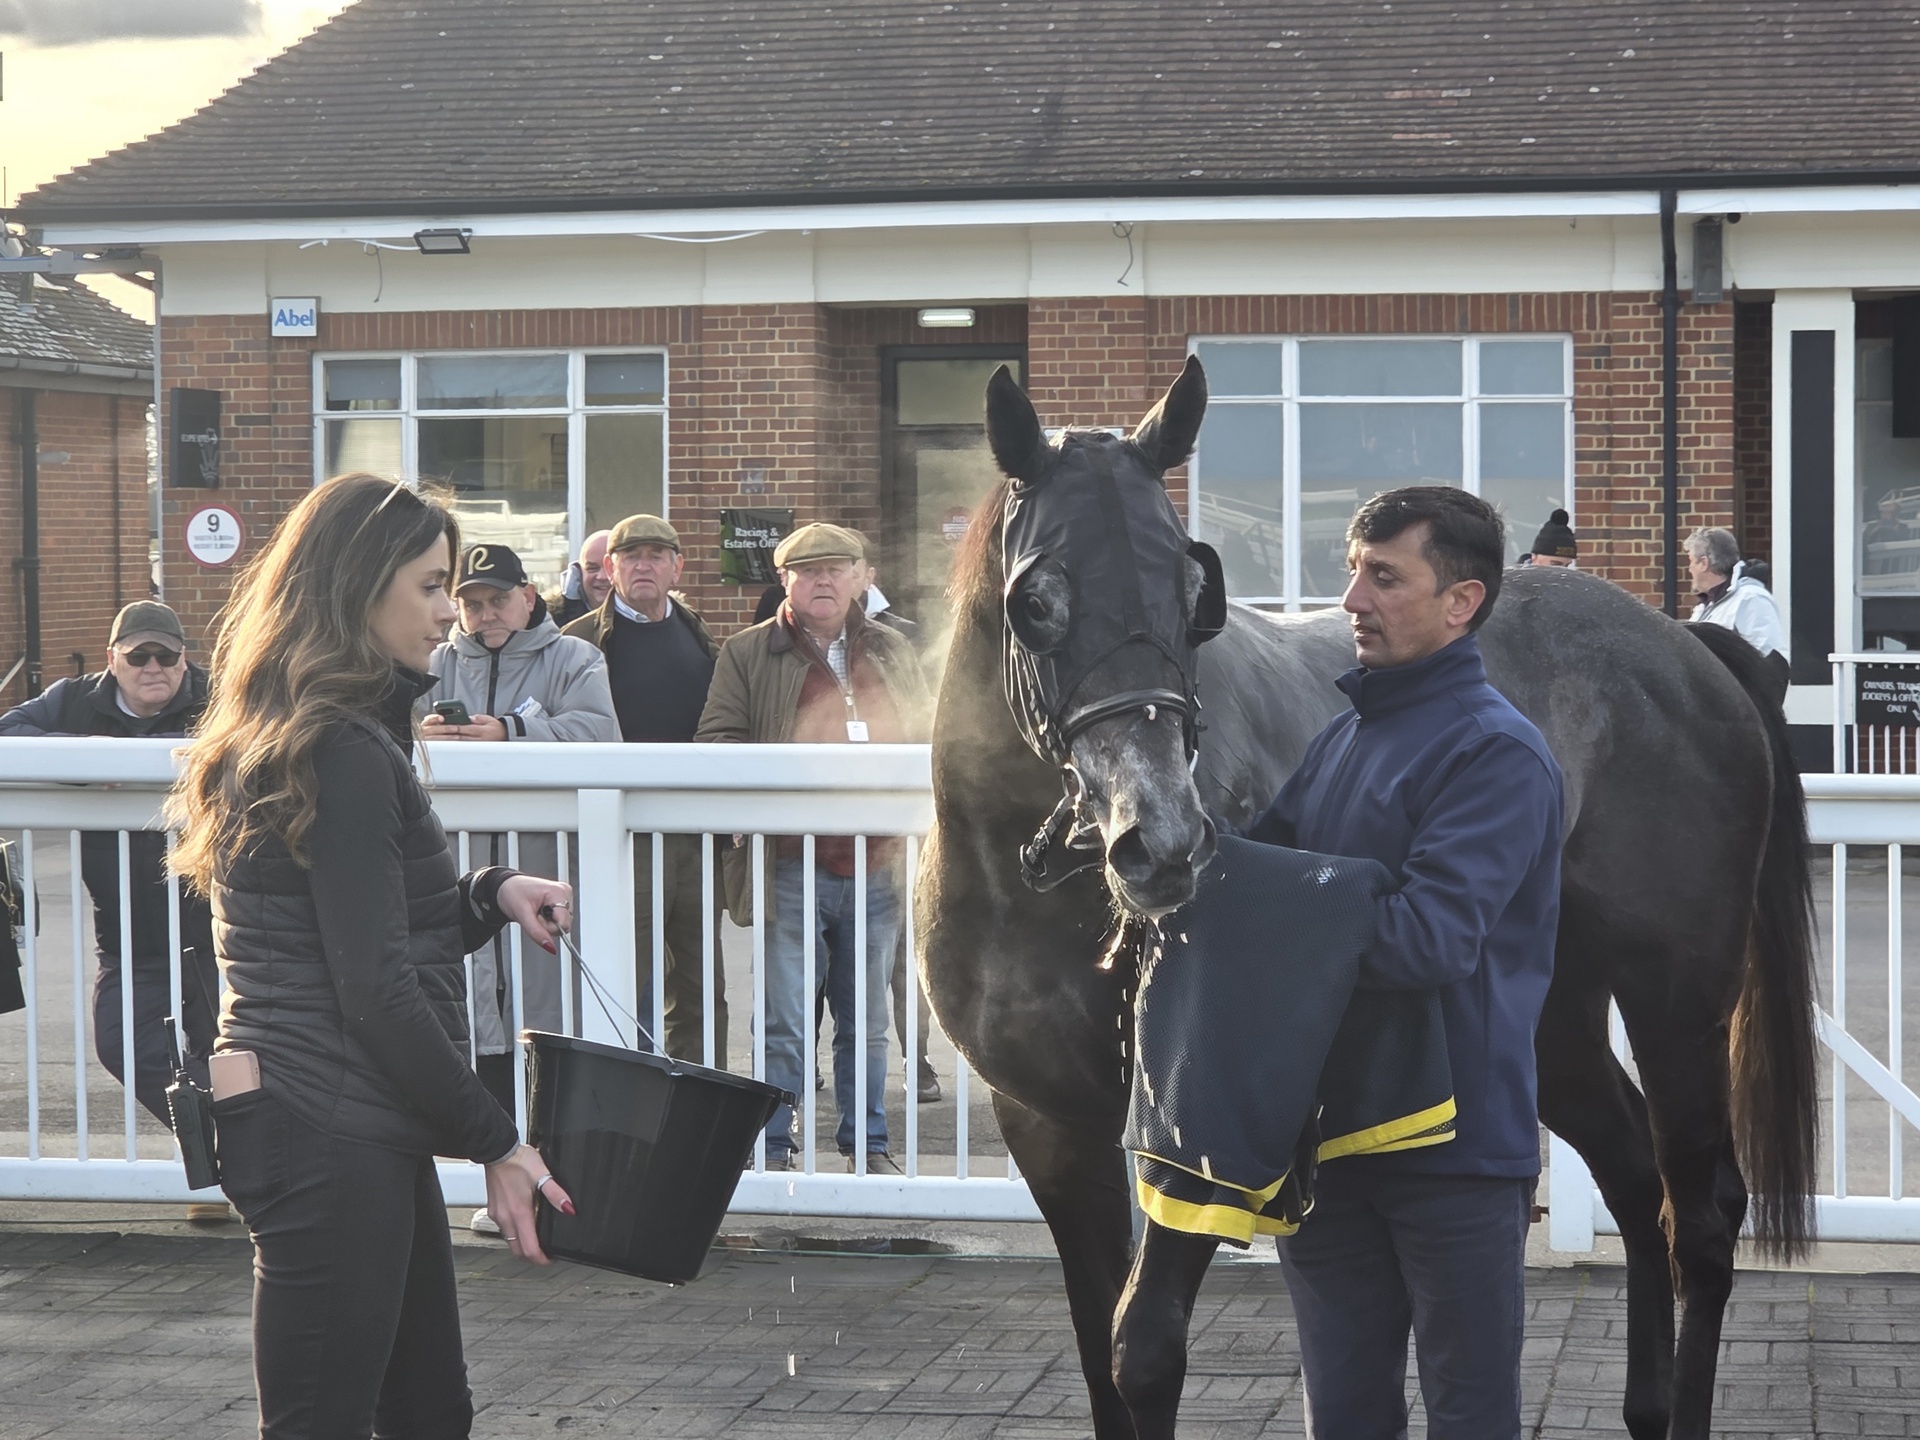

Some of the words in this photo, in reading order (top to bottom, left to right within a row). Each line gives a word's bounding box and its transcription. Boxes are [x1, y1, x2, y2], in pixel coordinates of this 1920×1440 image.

[273, 308, 314, 327] Abel
[207, 513, 220, 533] 9
[735, 527, 768, 539] Racing
[770, 527, 780, 537] &
[723, 539, 757, 549] Estates
[1862, 691, 1891, 701] JOCKEYS
[1886, 704, 1907, 713] ONLY
